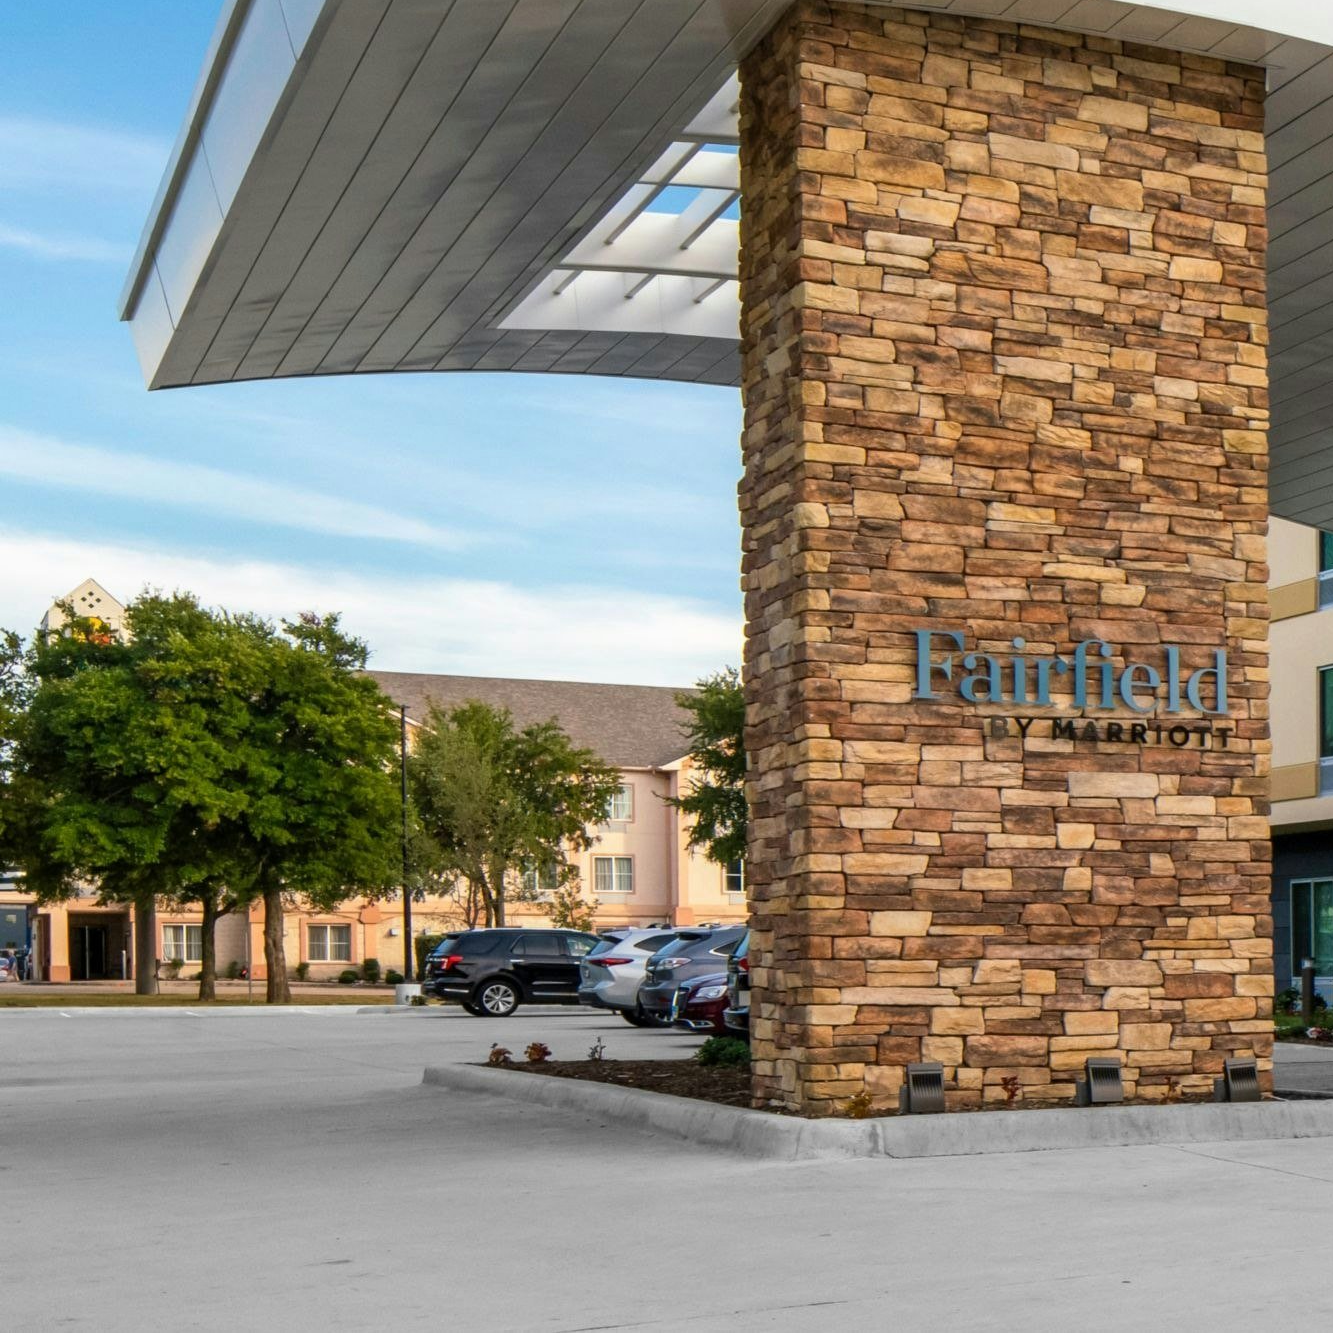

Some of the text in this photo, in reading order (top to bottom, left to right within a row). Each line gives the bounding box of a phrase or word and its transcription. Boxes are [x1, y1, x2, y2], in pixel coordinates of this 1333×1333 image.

[912, 628, 1229, 715] Fairfield
[990, 716, 1234, 748] BY MARRIOTT
